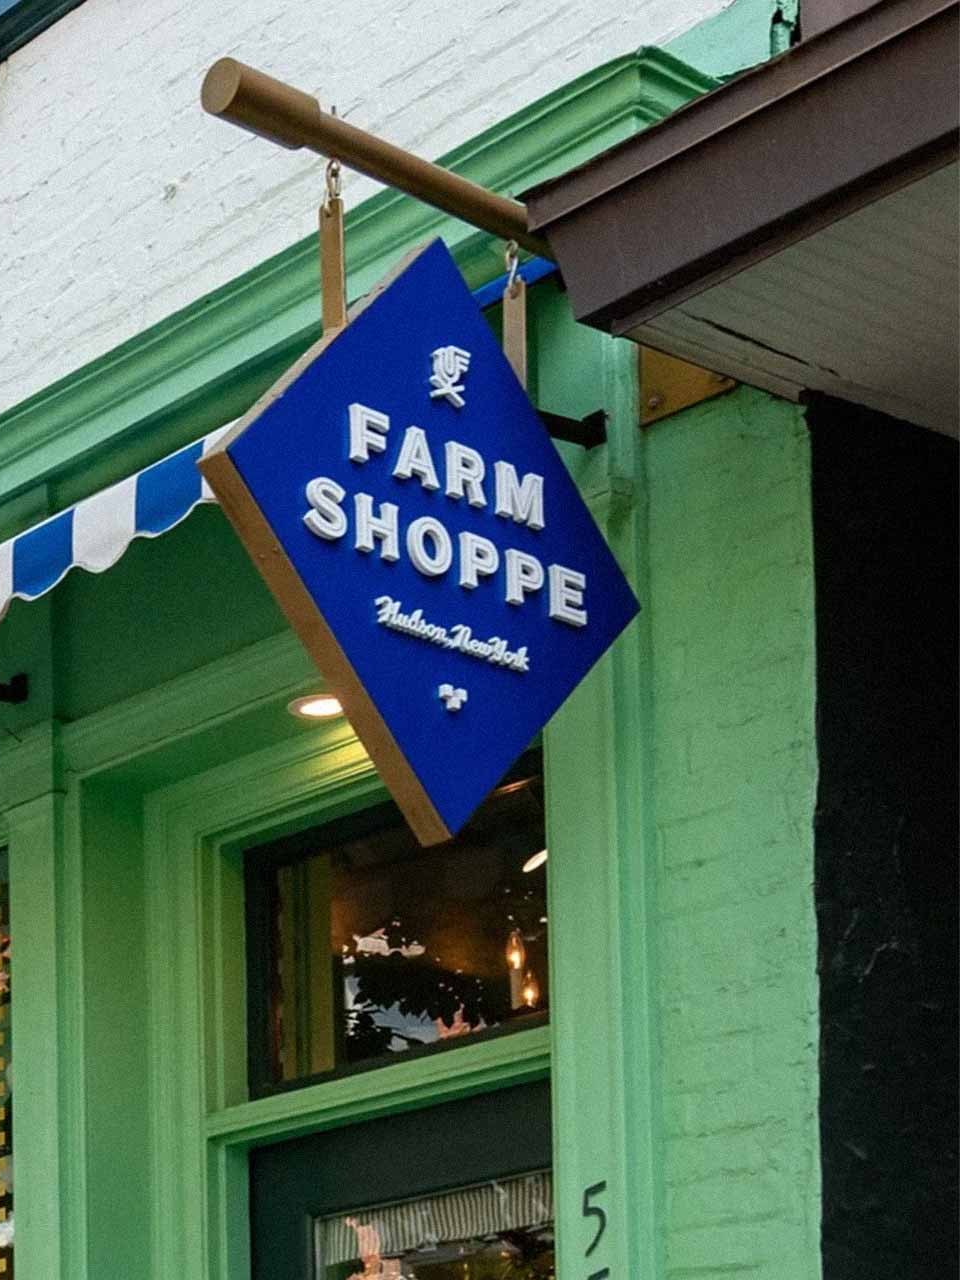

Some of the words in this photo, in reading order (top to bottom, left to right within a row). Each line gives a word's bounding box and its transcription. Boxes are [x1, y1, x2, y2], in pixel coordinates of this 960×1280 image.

[348, 403, 546, 531] FARM
[304, 477, 588, 628] SHOPPE
[451, 623, 494, 658] New
[488, 636, 530, 672] York
